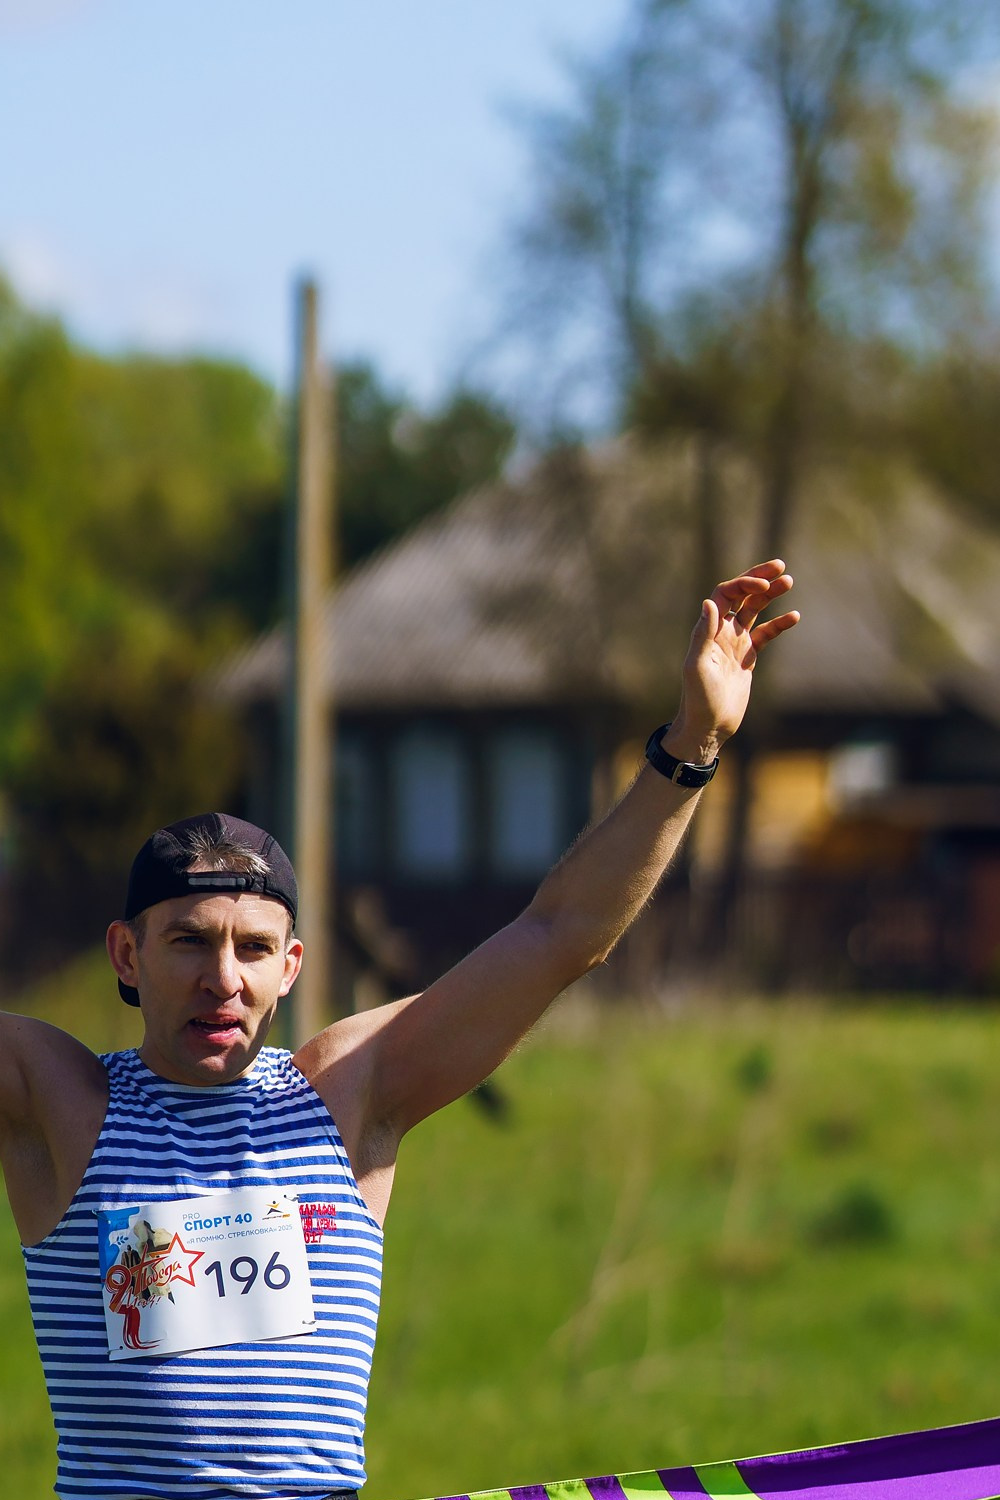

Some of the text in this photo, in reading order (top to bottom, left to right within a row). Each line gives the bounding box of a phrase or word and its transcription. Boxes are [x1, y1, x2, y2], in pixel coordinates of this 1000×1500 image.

[182, 1212, 201, 1220] PRO
[184, 1215, 232, 1231] СПОРТ
[234, 1212, 253, 1225] 40
[278, 1224, 293, 1232] 2025
[204, 1251, 291, 1298] 196
